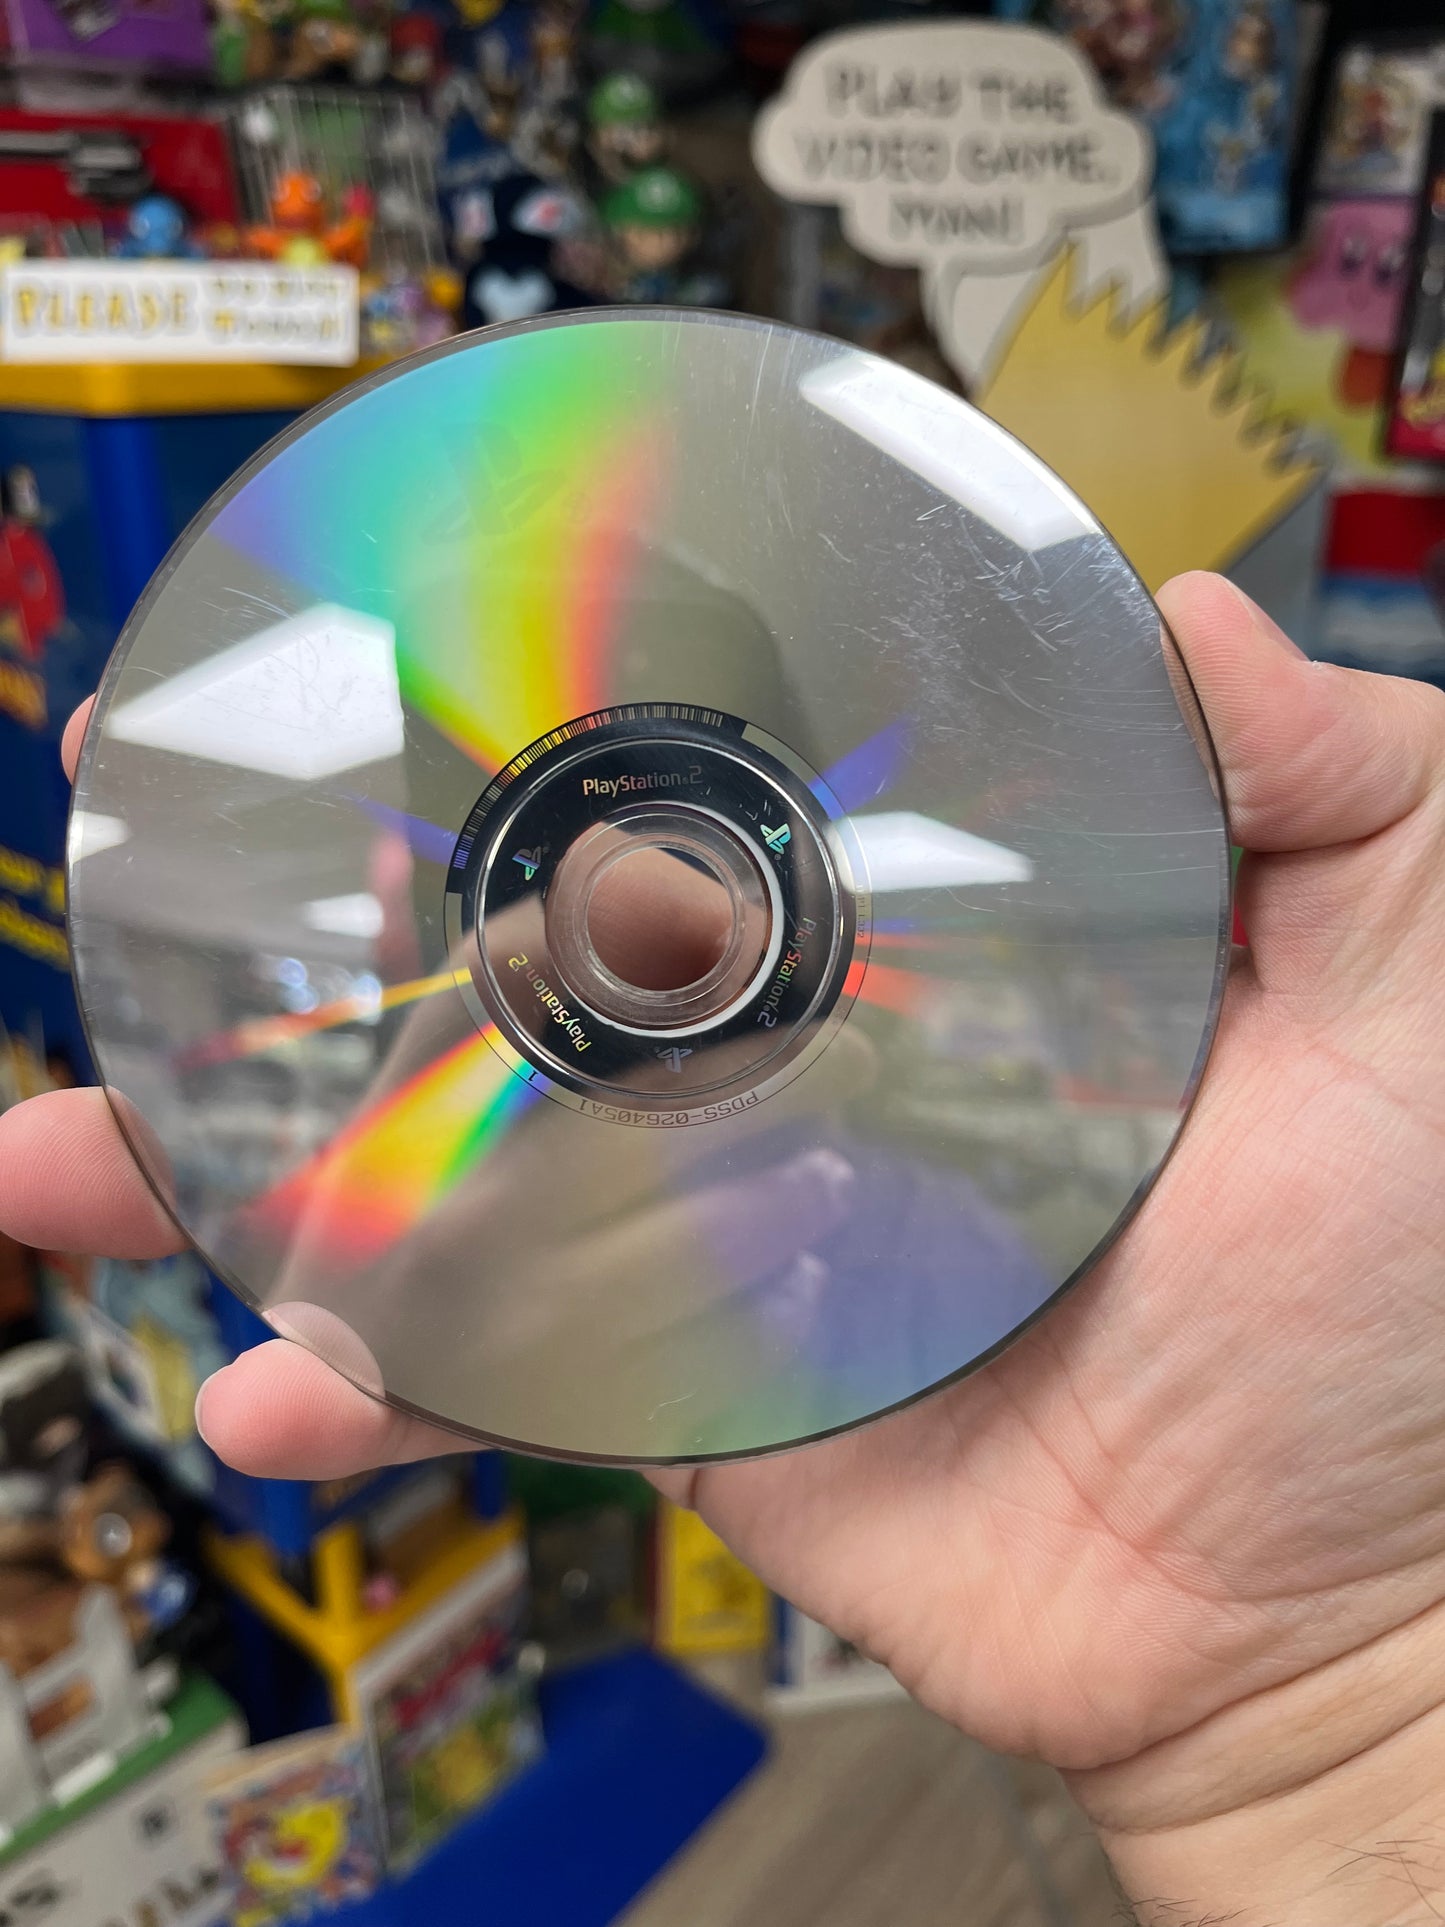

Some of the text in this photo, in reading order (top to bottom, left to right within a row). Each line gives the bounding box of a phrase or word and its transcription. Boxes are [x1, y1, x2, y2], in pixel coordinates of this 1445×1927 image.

[794, 129, 951, 183] VIDEO
[13, 280, 195, 336] PLEASE
[578, 1090, 759, 1127] PDSS-026405A1
